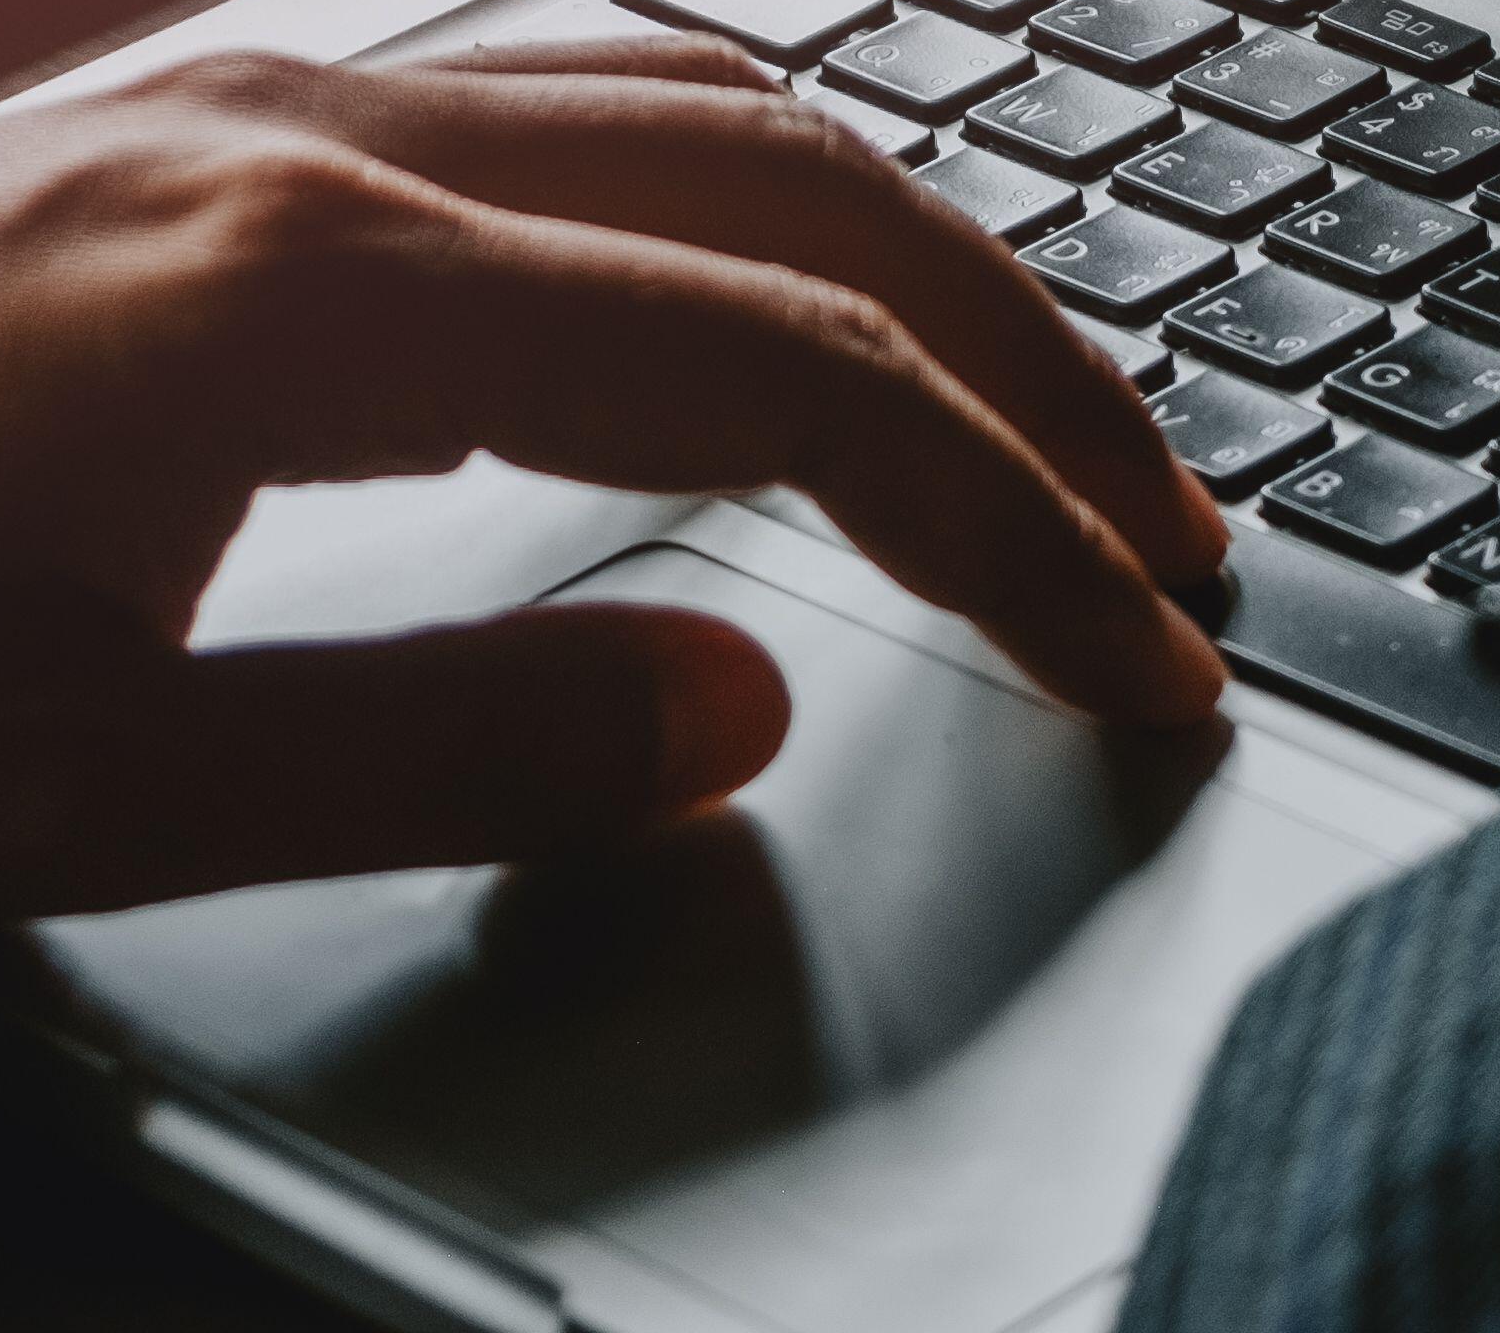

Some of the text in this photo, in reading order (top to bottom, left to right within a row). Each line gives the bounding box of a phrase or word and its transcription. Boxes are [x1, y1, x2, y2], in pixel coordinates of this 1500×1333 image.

[1058, 6, 1098, 25] 2
[855, 44, 900, 67] Q
[1247, 40, 1285, 59] #
[1423, 41, 1449, 54] F3
[1202, 62, 1240, 82] 3
[999, 96, 1057, 123] W
[1397, 91, 1435, 110] $
[1358, 118, 1395, 134] 4
[1141, 151, 1186, 175] E
[1294, 210, 1340, 235] R
[1039, 237, 1088, 261] D
[1458, 268, 1500, 291] T
[1192, 297, 1242, 317] F
[1361, 363, 1411, 387] G
[1293, 470, 1344, 498] B
